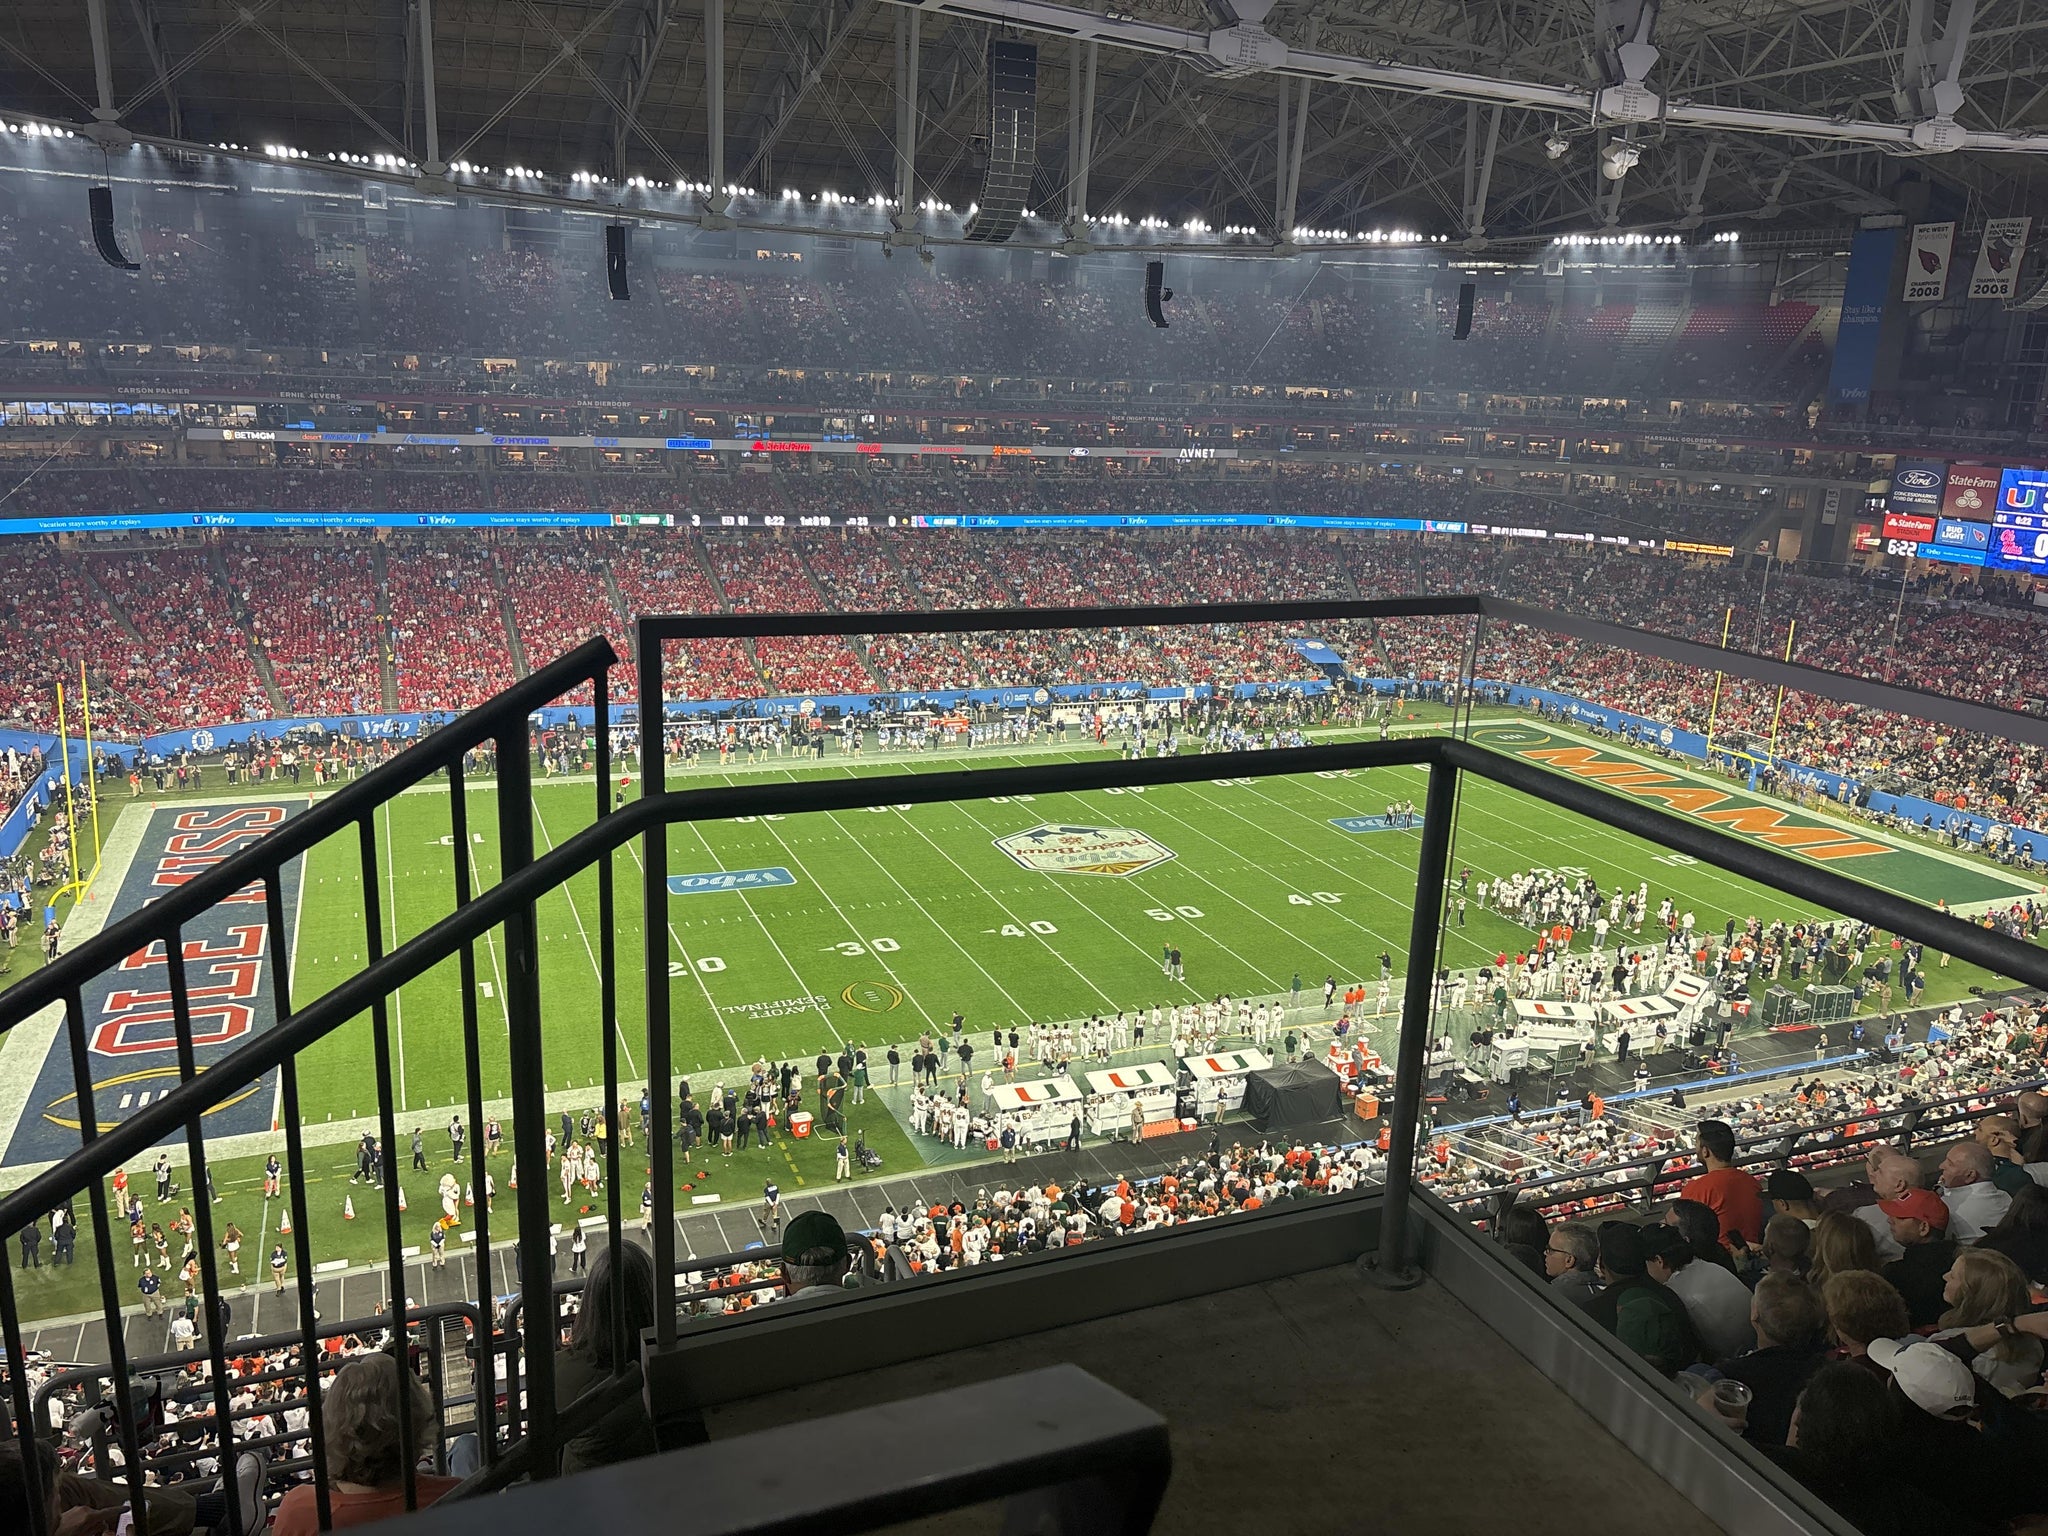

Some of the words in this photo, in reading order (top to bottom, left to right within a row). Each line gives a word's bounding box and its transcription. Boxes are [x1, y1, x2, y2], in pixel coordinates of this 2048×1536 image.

[1917, 233, 1949, 241] DIVISION
[1908, 287, 1940, 297] 2008
[1973, 284, 2009, 294] 2008
[1844, 305, 1860, 315] Stay
[1861, 305, 1876, 314] like
[117, 387, 154, 395] CARSON
[234, 431, 276, 441] BETMGM
[508, 437, 550, 445] HYUNDAI
[1179, 448, 1216, 458] AVNET
[1904, 472, 1932, 485] Ford
[2006, 488, 2036, 508] U
[119, 518, 141, 526] replays
[205, 515, 235, 525] Vrbo
[303, 517, 319, 525] stays
[320, 516, 343, 525] worthy
[353, 517, 375, 525] replays
[429, 515, 456, 525] Vrbo
[515, 517, 531, 525] stays
[531, 517, 551, 525] worthy
[560, 517, 580, 525] replays
[691, 515, 701, 527] 3
[978, 515, 1000, 525] Vrbo
[1128, 516, 1148, 525] Vrbo
[1275, 516, 1297, 525] Vrbo
[1945, 525, 1963, 533] BUD
[1941, 532, 1965, 540] LIGHT
[1888, 539, 1918, 558] 6:22
[361, 720, 411, 735] Vrbo
[1515, 746, 1900, 860] MIAMI
[1083, 838, 1151, 853] Fiesta
[1016, 847, 1081, 856] Bowl
[1055, 850, 1139, 864] Vrbo
[1651, 854, 1698, 867] 10
[681, 870, 781, 887] Vrbo
[1288, 891, 1342, 906] 40
[1144, 905, 1205, 923] 50
[1000, 920, 1059, 938] 40
[835, 936, 901, 957] 30
[721, 995, 827, 1014] SEMIFINAL
[748, 1002, 833, 1020] PLAYOFF
[1205, 1054, 1250, 1072] U
[1341, 1064, 1350, 1075] G
[1108, 1069, 1153, 1088] U
[1014, 1083, 1061, 1102] U
[798, 1124, 808, 1134] G
